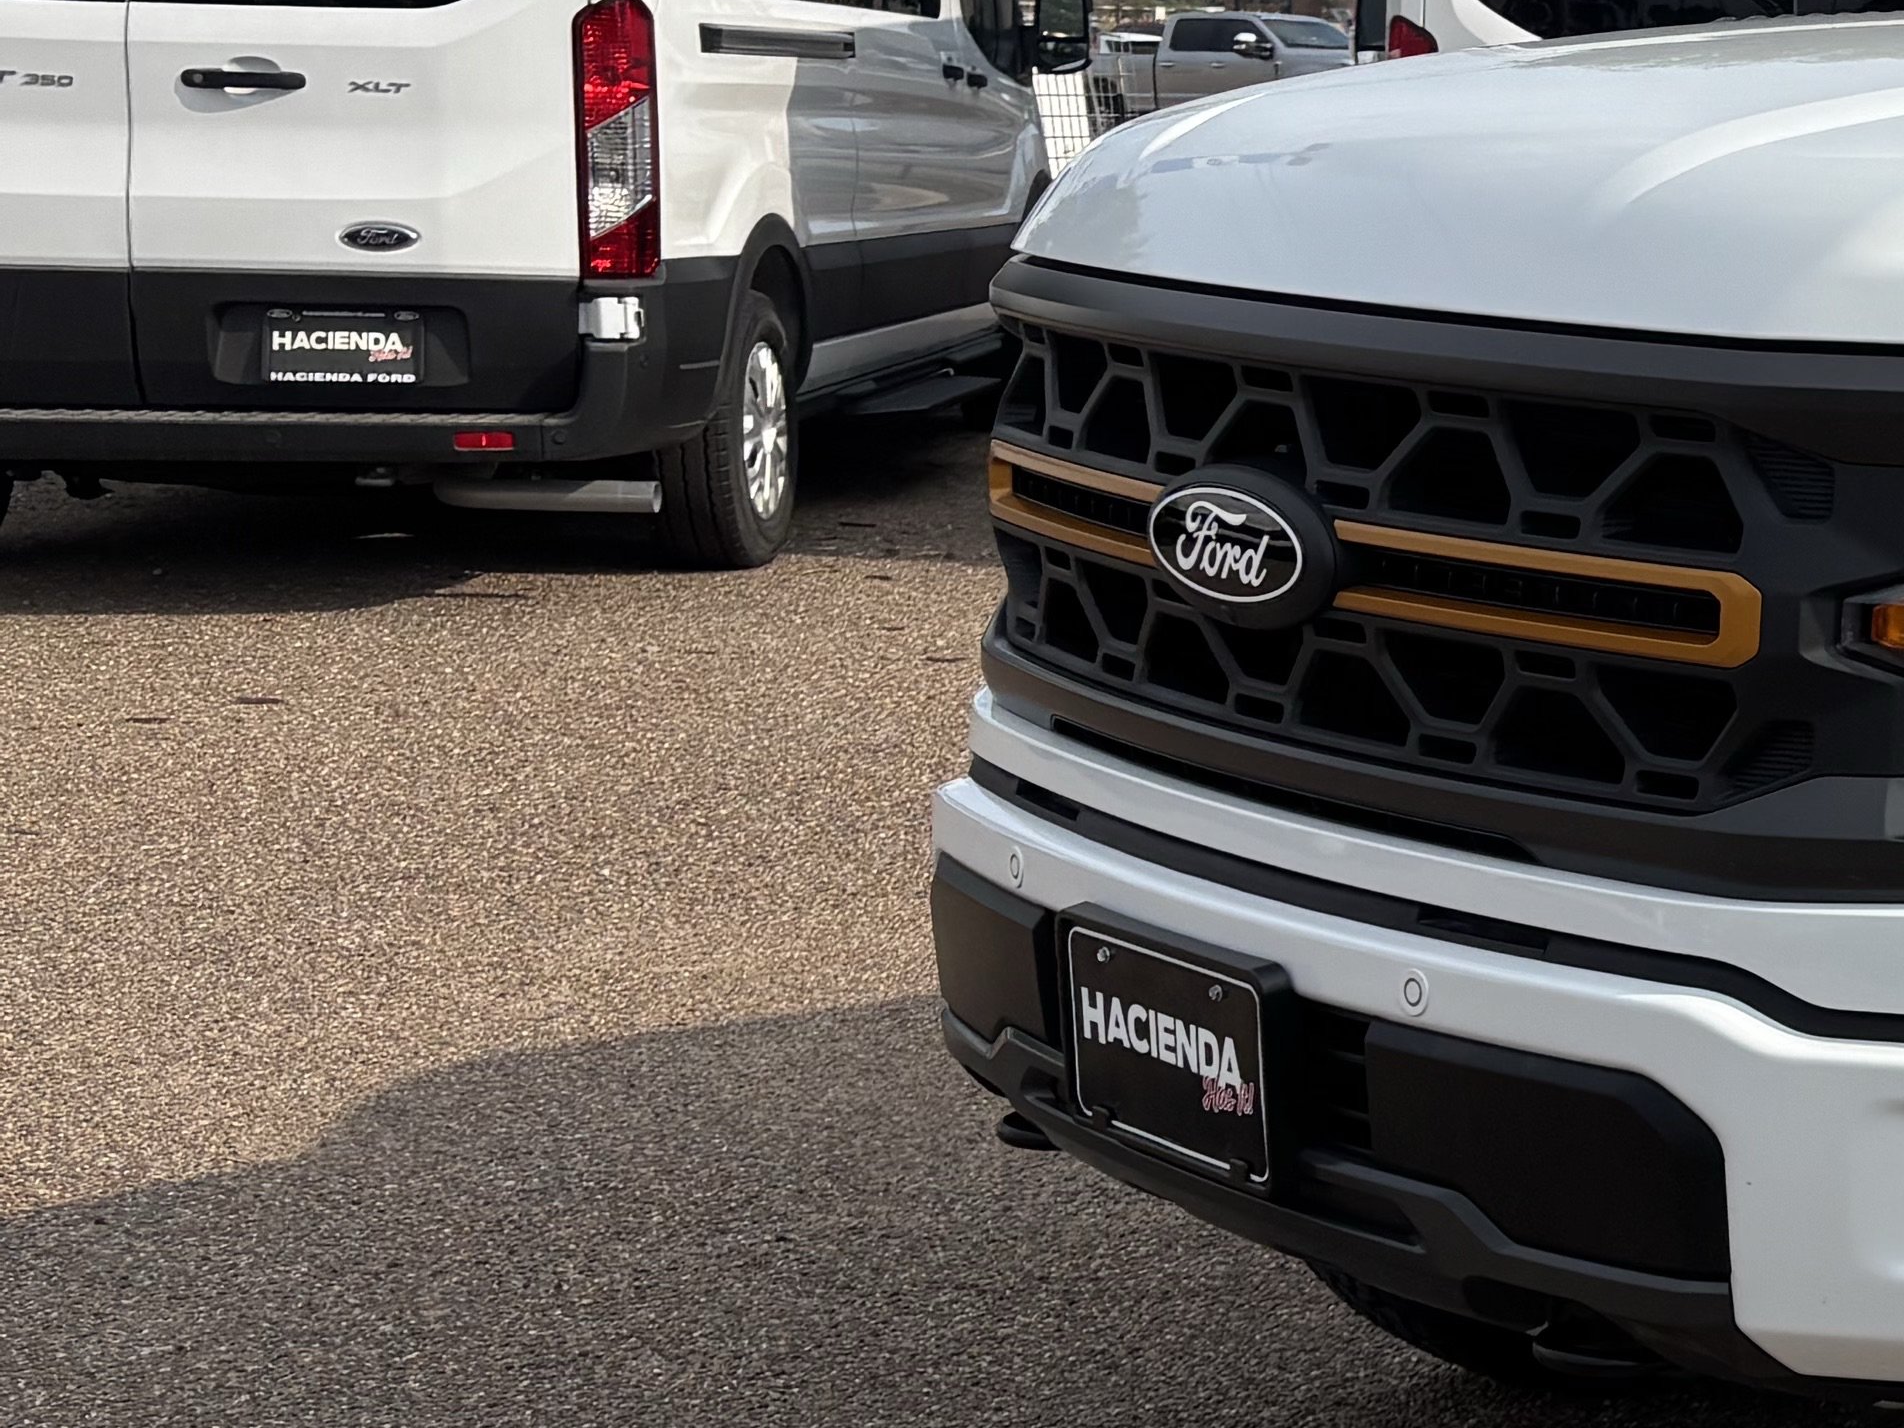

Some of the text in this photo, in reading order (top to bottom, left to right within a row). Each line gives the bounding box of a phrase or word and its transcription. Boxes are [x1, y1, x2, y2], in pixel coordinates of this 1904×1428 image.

[20, 73, 74, 87] 350
[347, 79, 412, 94] XLT
[355, 228, 400, 247] Ford
[271, 330, 404, 351] HACIENDA
[269, 371, 417, 384] HACIENDA FORD
[1175, 500, 1270, 588] Ford
[1080, 986, 1243, 1094] HACIENDA
[1201, 1075, 1237, 1113] Has
